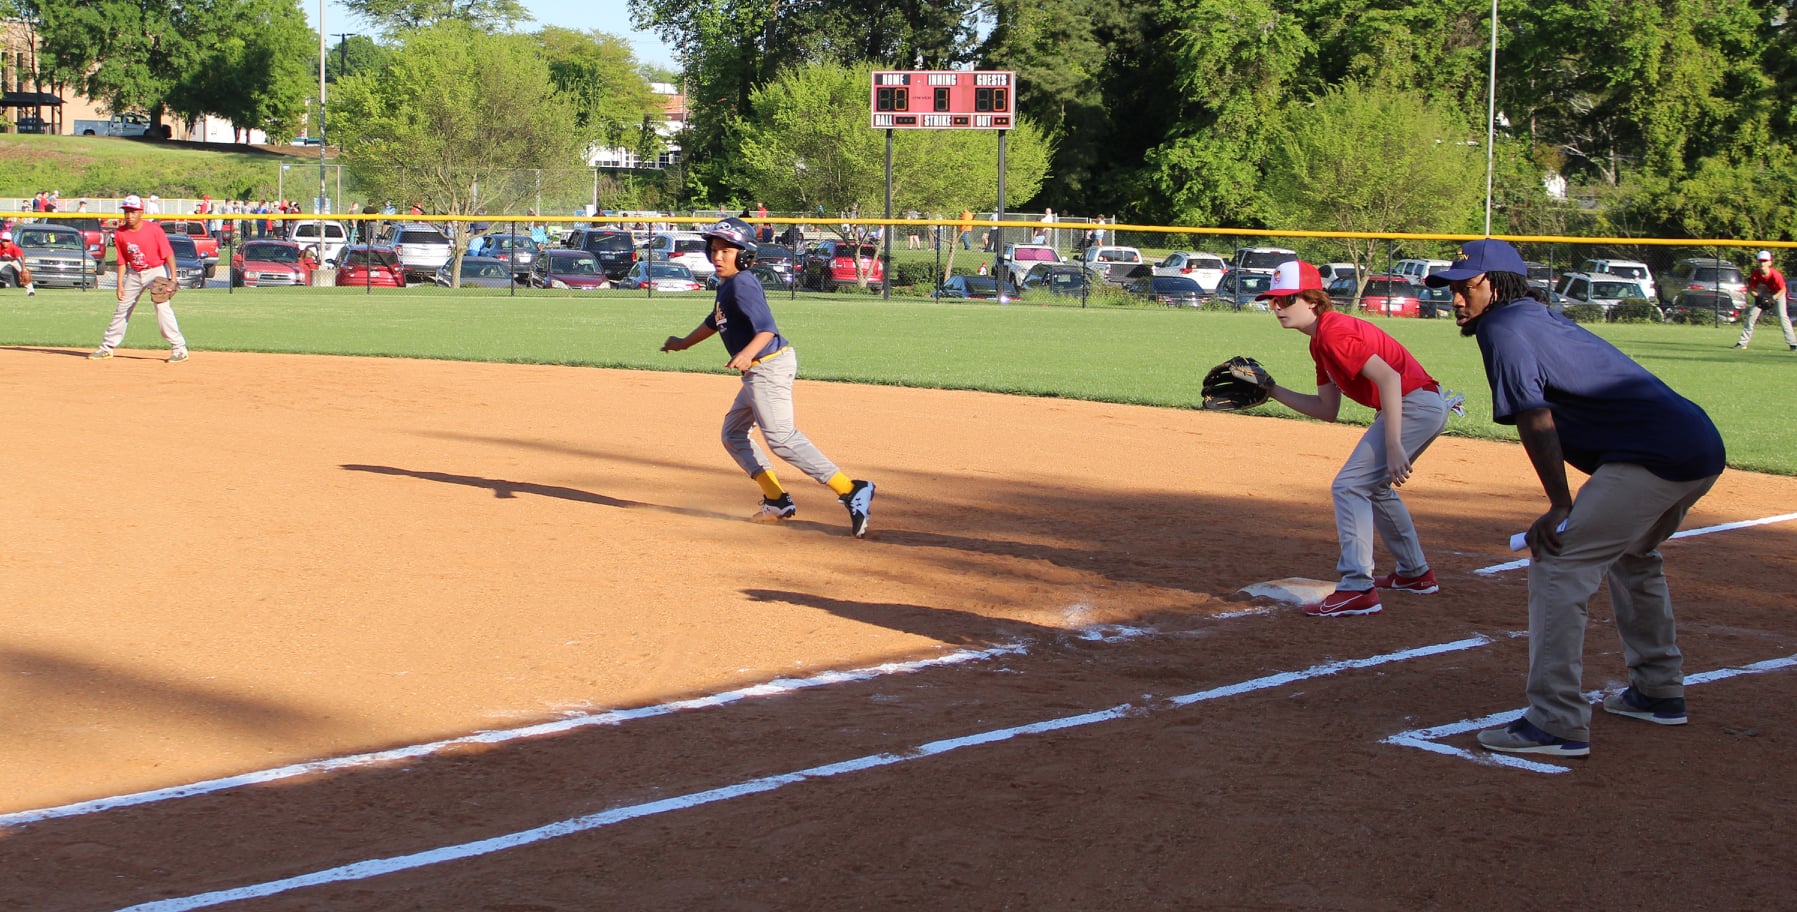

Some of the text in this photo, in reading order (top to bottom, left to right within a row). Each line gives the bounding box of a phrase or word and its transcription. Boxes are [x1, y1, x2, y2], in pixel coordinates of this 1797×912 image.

[882, 74, 904, 85] HOME
[928, 74, 957, 86] INNING
[976, 74, 1007, 85] GUESTS
[875, 115, 893, 126] BALL
[924, 115, 951, 127] STRIKE
[976, 115, 992, 127] OUT
